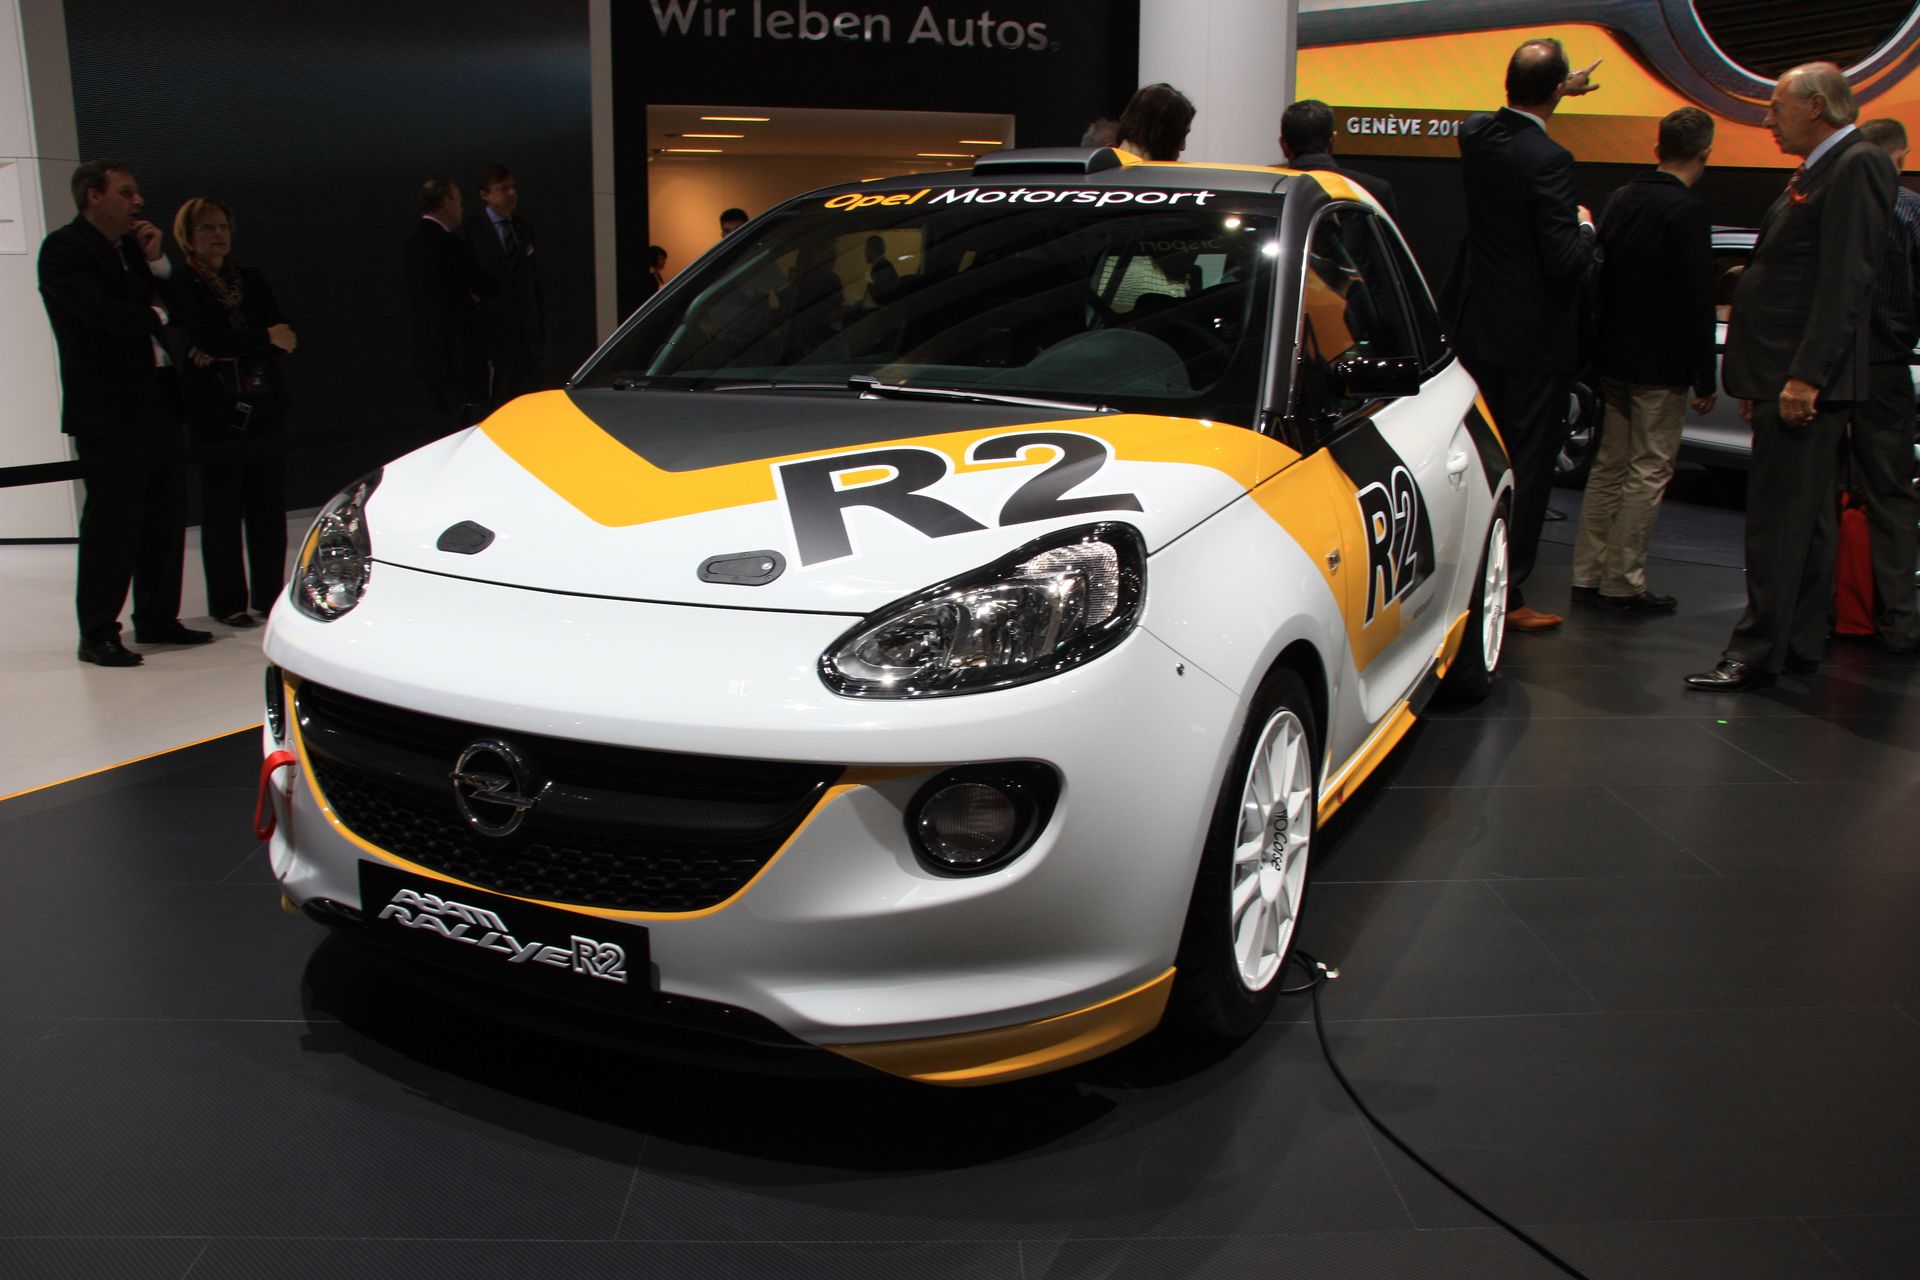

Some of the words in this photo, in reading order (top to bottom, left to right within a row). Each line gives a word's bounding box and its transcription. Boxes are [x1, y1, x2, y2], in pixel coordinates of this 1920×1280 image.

[653, 0, 736, 37] Wir
[752, 0, 891, 42] leben
[1346, 113, 1422, 135] GENÈVE
[1427, 119, 1464, 136] 201
[823, 188, 932, 212] Opel
[928, 187, 1216, 207] Motorsport
[772, 430, 1148, 571] R2
[1355, 466, 1418, 630] R2
